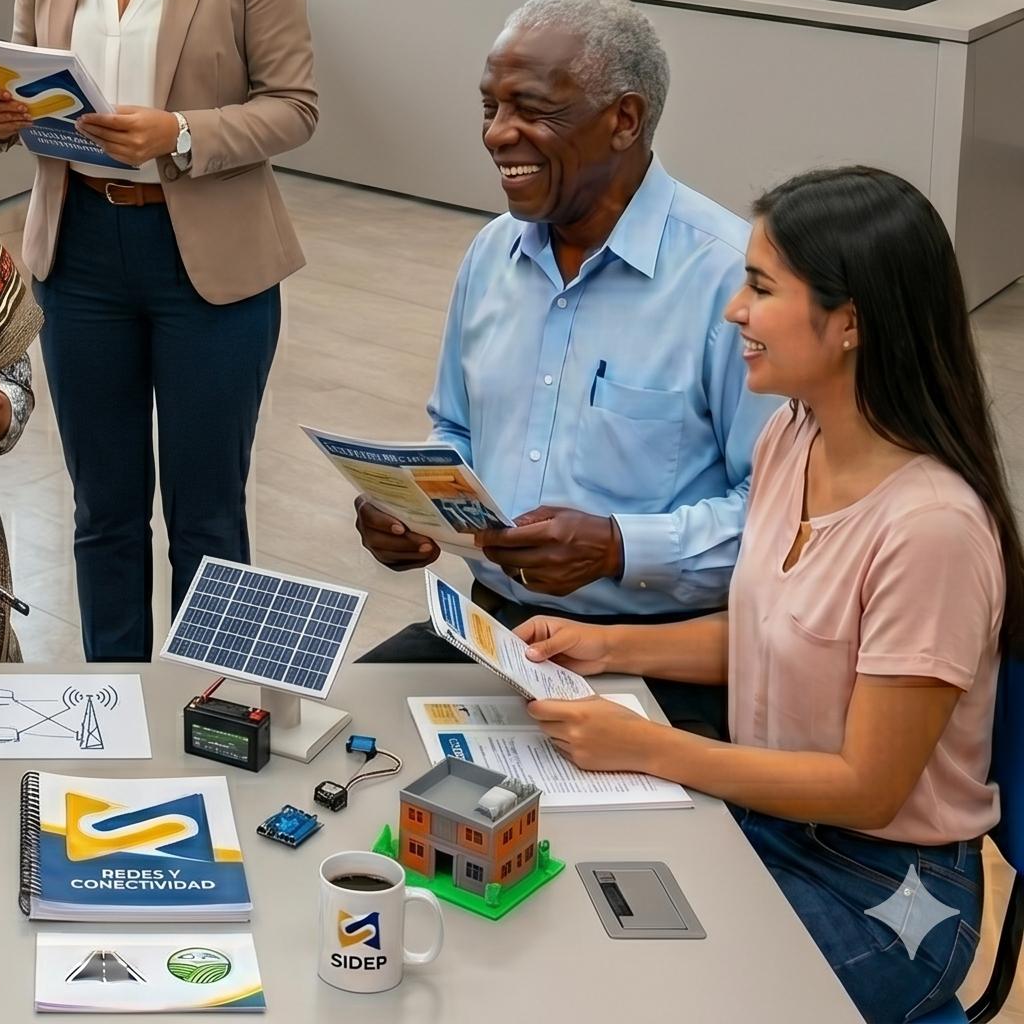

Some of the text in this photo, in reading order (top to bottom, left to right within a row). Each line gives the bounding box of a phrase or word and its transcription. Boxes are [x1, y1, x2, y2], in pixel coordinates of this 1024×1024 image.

[102, 869, 181, 880] REDES Y
[71, 879, 216, 891] CONECTIVIDAD
[330, 952, 388, 971] SIDEP
